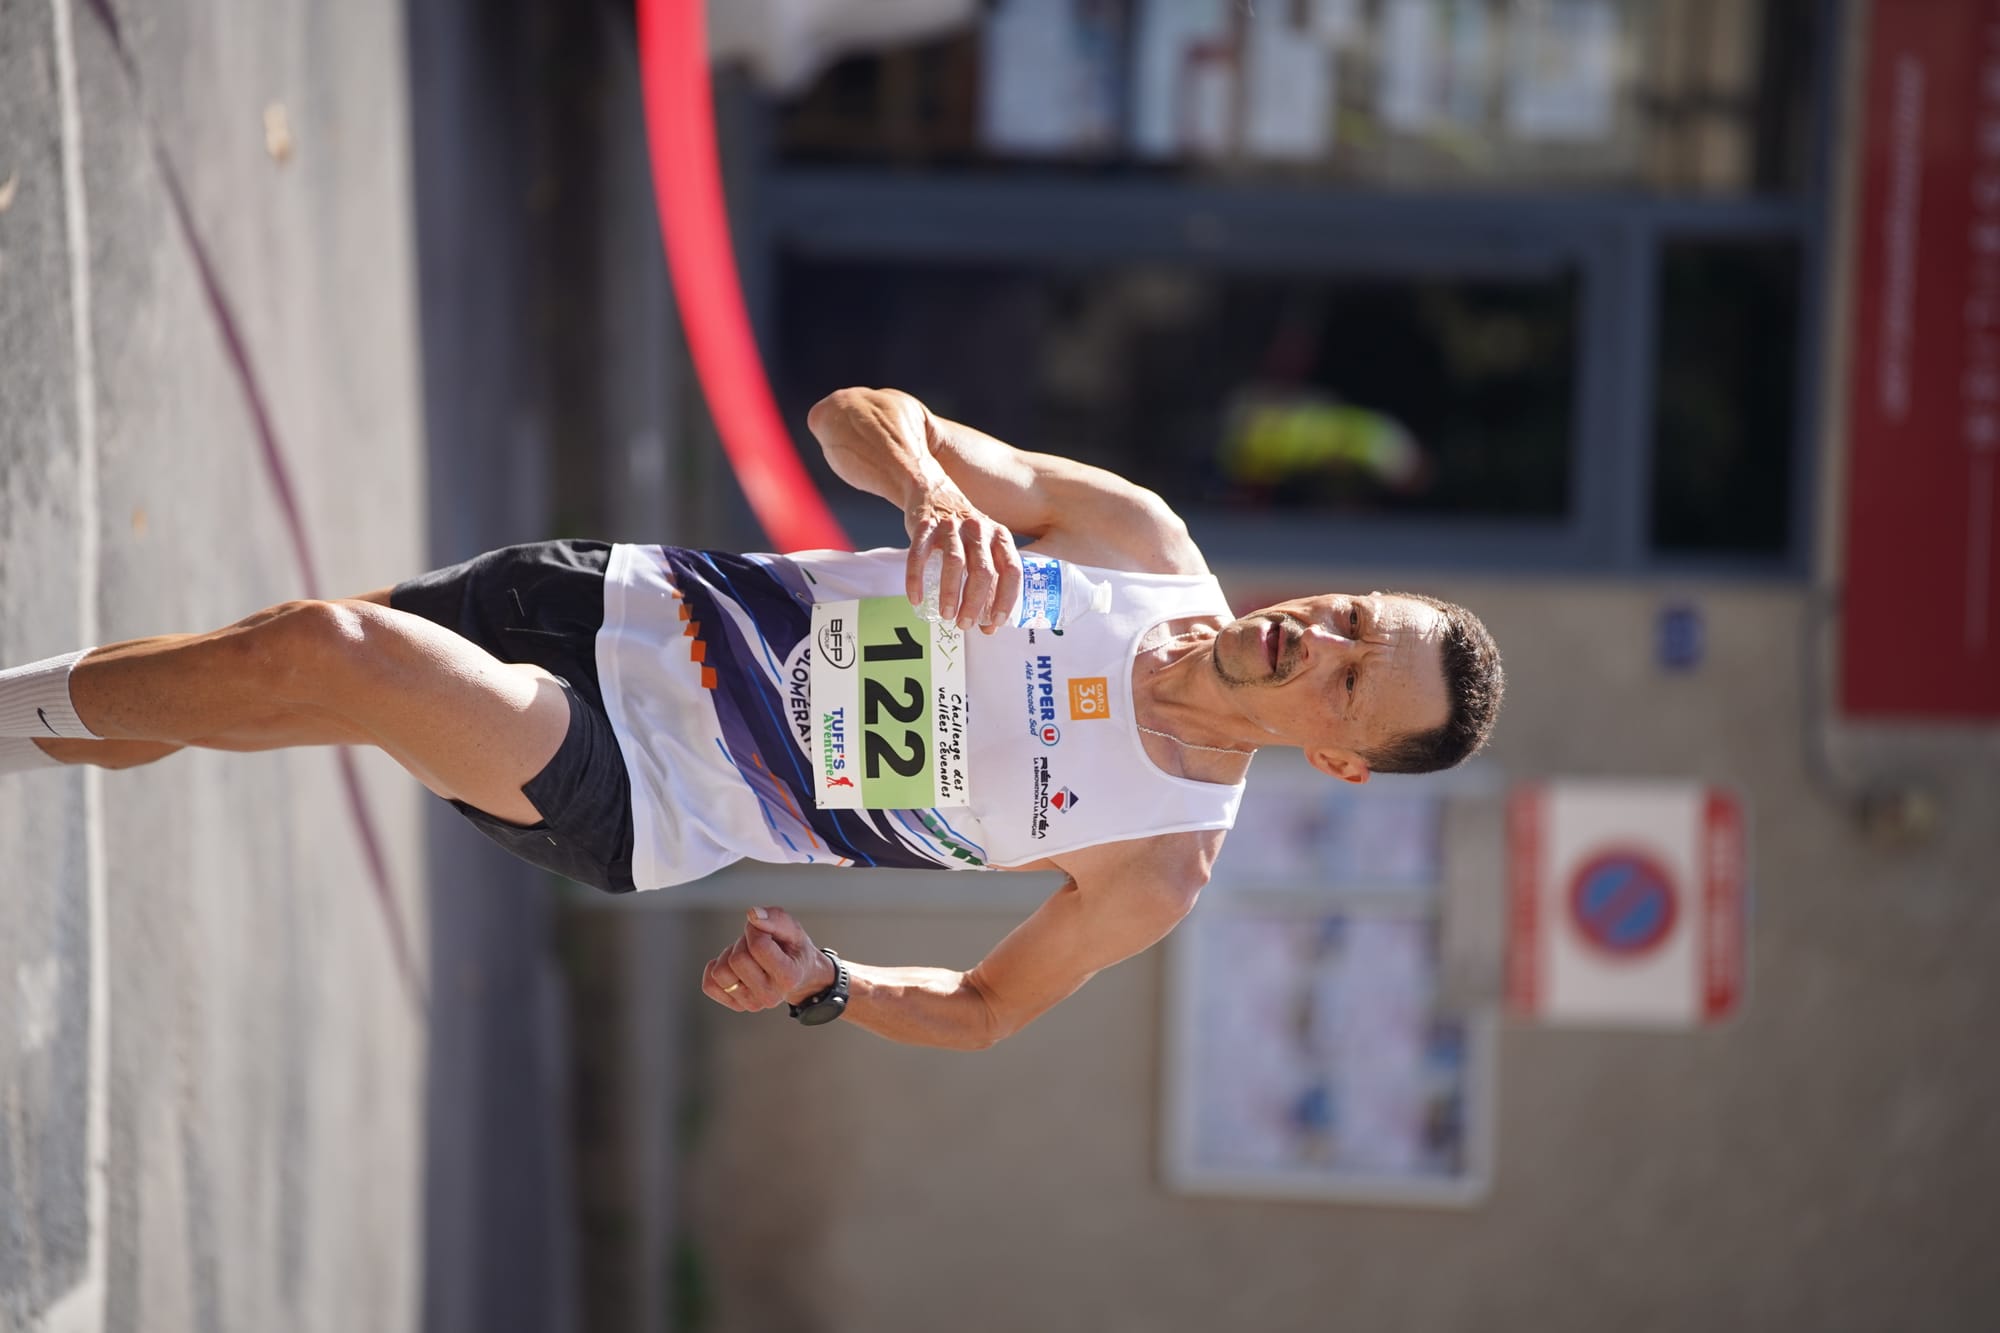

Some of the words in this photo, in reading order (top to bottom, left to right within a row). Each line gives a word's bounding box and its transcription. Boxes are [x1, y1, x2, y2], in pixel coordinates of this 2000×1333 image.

[830, 618, 843, 661] BFP
[790, 649, 811, 751] LOMÉRA
[1025, 661, 1034, 681] Alès
[1026, 683, 1035, 715] Rocade
[1037, 656, 1055, 721] HYPER
[863, 626, 926, 779] 122
[938, 687, 949, 733] vallées
[949, 694, 962, 761] Challenge
[1029, 718, 1039, 736] Sud
[824, 713, 836, 777] Aventure
[832, 707, 845, 770] TUFF'S
[939, 741, 951, 798] cévenoles
[953, 769, 964, 791] des
[1038, 757, 1051, 839] RÉNOVÉA
